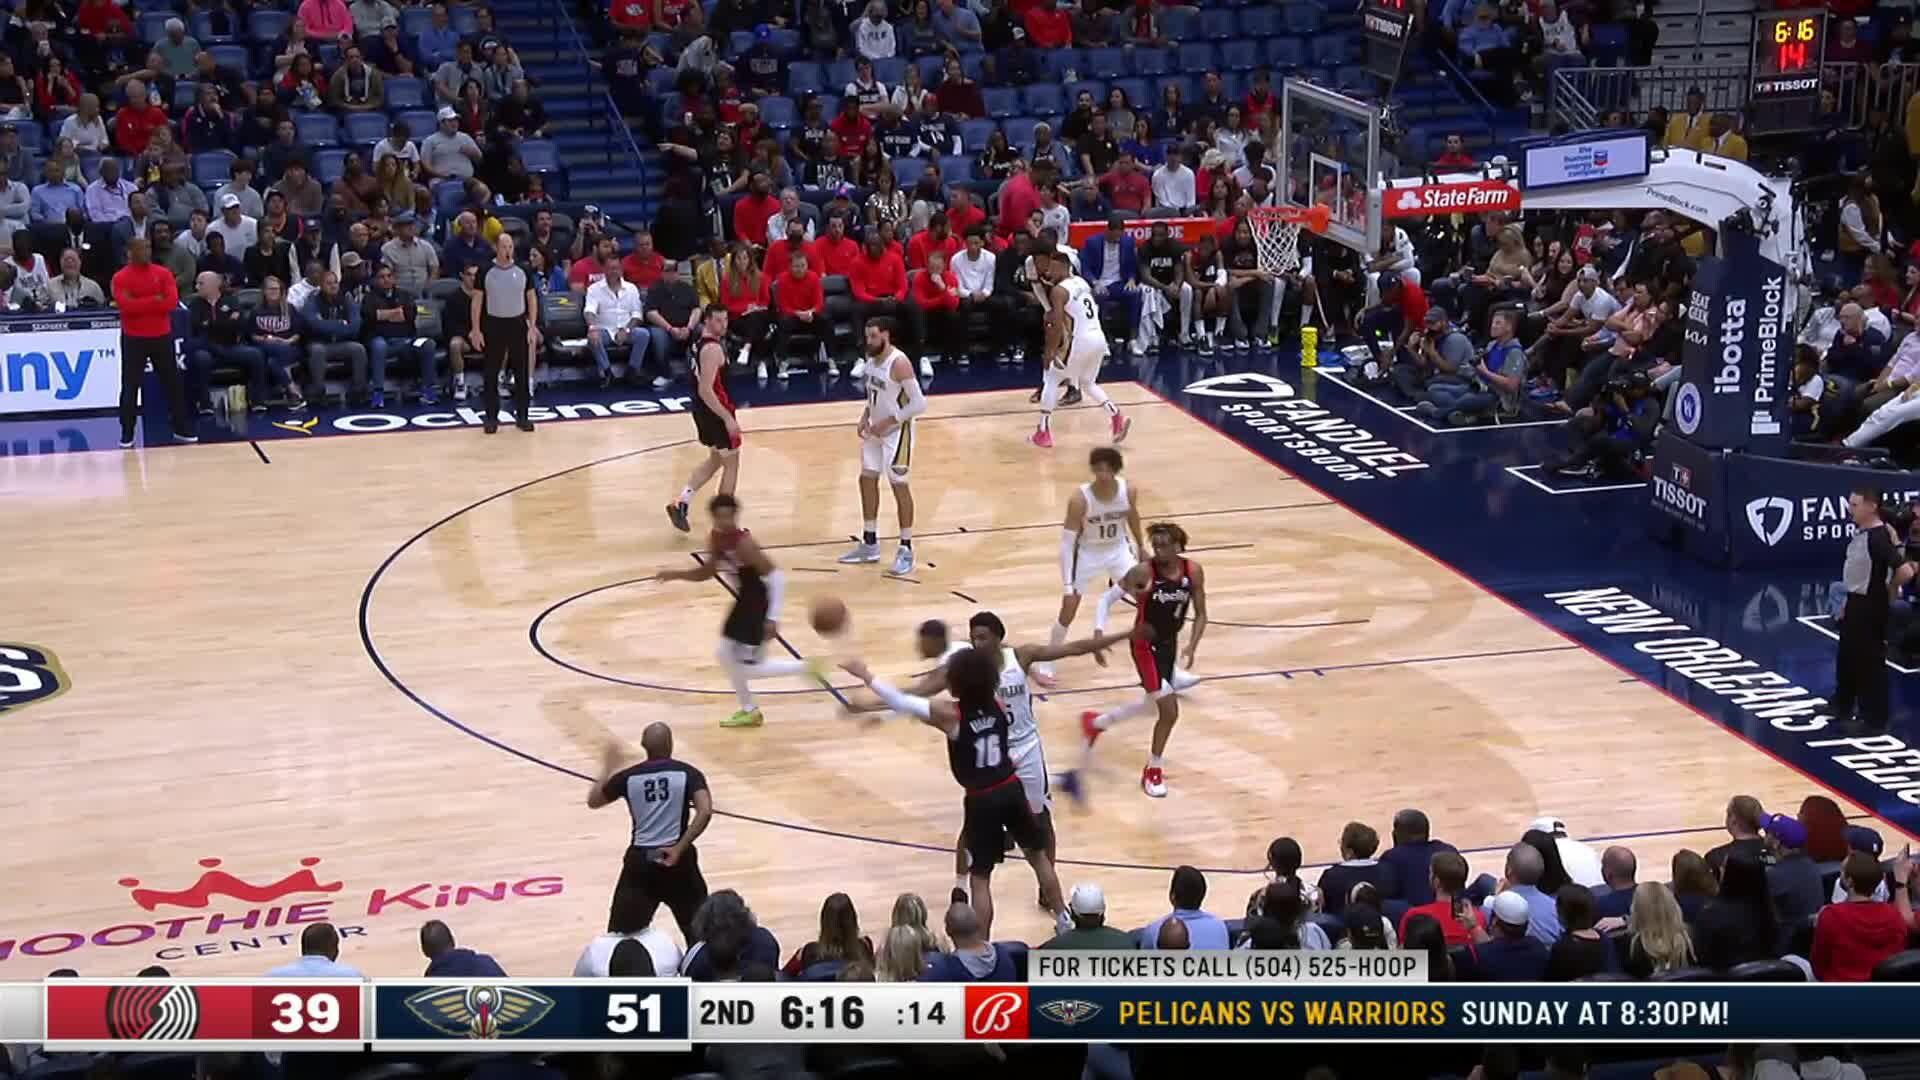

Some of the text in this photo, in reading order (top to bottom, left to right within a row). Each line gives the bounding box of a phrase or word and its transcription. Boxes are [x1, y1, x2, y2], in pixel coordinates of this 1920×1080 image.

[1775, 19, 1814, 43] 6:16
[1773, 78, 1818, 91] TISSOT
[1083, 298, 1094, 319] 3
[1713, 299, 1746, 394] ibotta
[1755, 276, 1782, 402] PrimeBlock
[332, 396, 692, 431] Ochsner
[1221, 403, 1374, 481] SPORTSBOOK
[1261, 400, 1430, 478] FANDUEL
[1653, 475, 1707, 518] TISSOT
[1099, 523, 1117, 540] 10
[1544, 586, 1691, 634] NEW
[1633, 636, 1835, 732] ORLEANS
[974, 733, 1001, 769] 16
[644, 777, 670, 803] 23
[155, 925, 368, 961] CENTR
